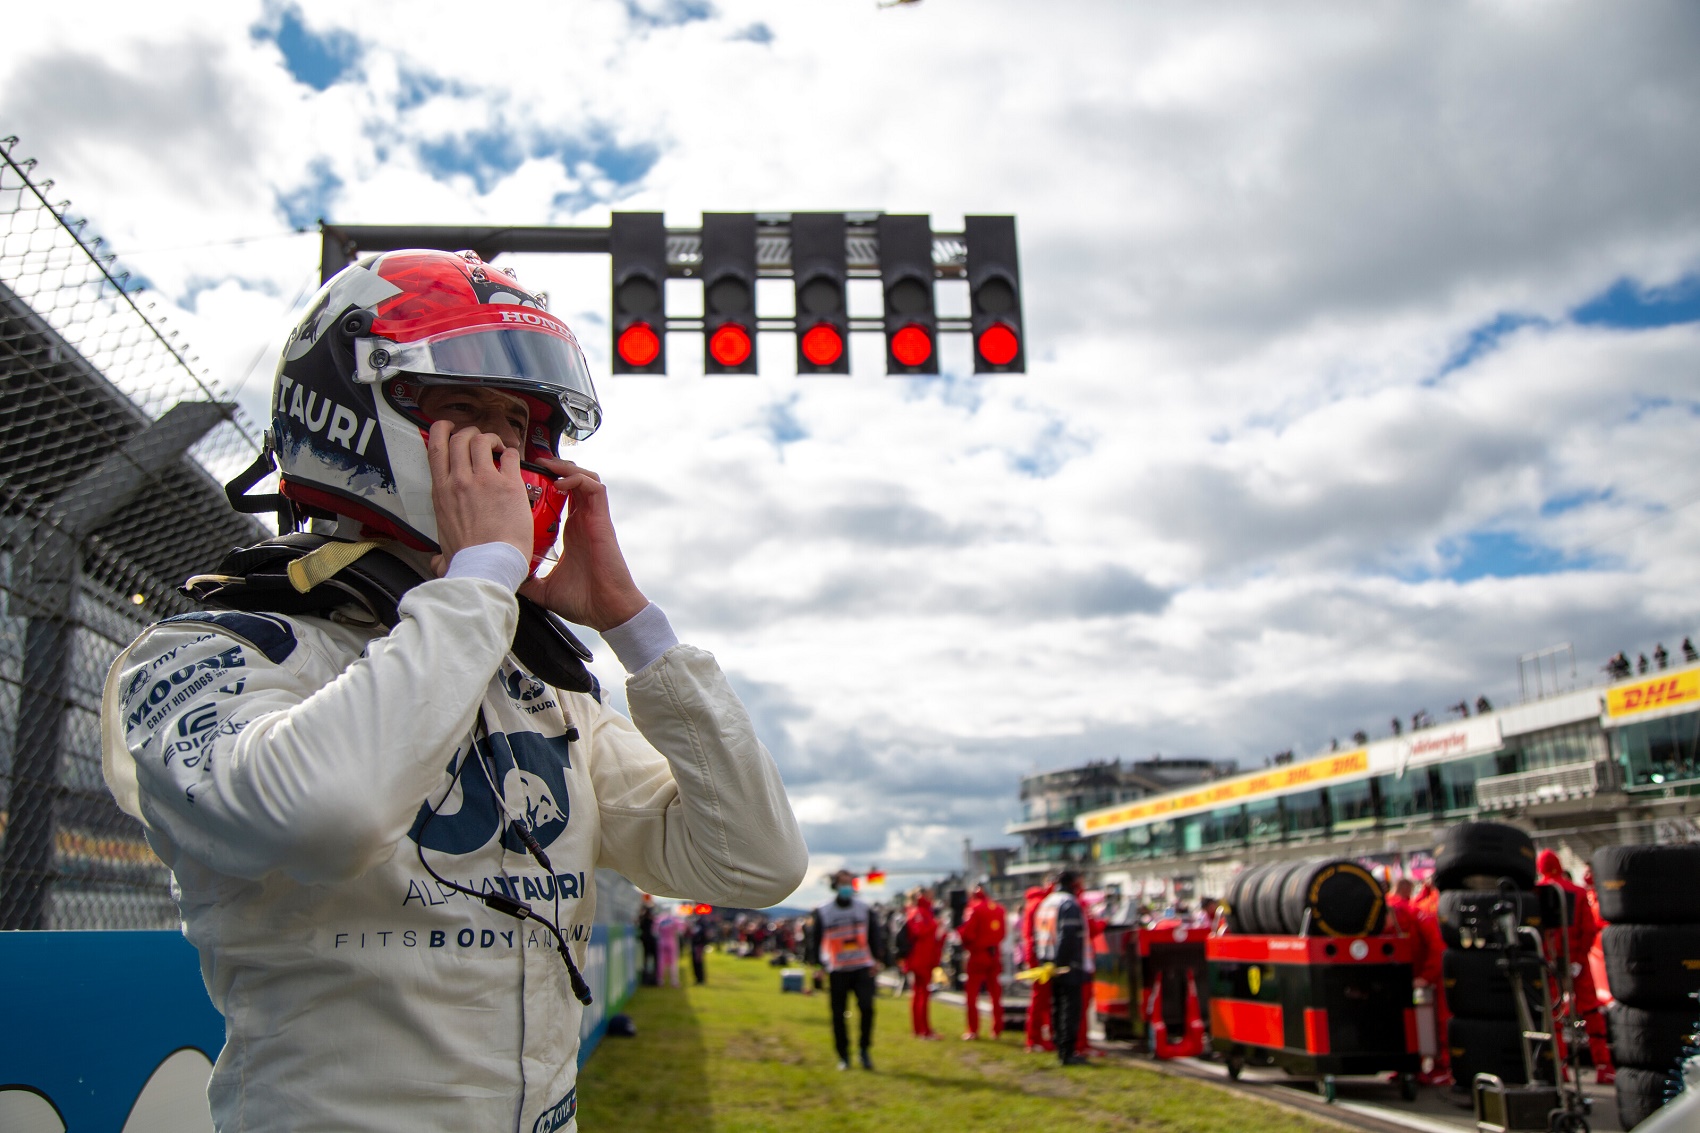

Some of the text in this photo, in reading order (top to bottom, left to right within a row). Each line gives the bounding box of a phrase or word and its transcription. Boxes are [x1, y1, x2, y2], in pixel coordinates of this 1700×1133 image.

[278, 375, 377, 456] TAURI
[147, 703, 171, 730] CRAFT
[172, 672, 214, 706] HOTDOGS
[1624, 679, 1685, 710] DHL
[335, 930, 418, 949] FITS
[429, 928, 514, 948] BODY
